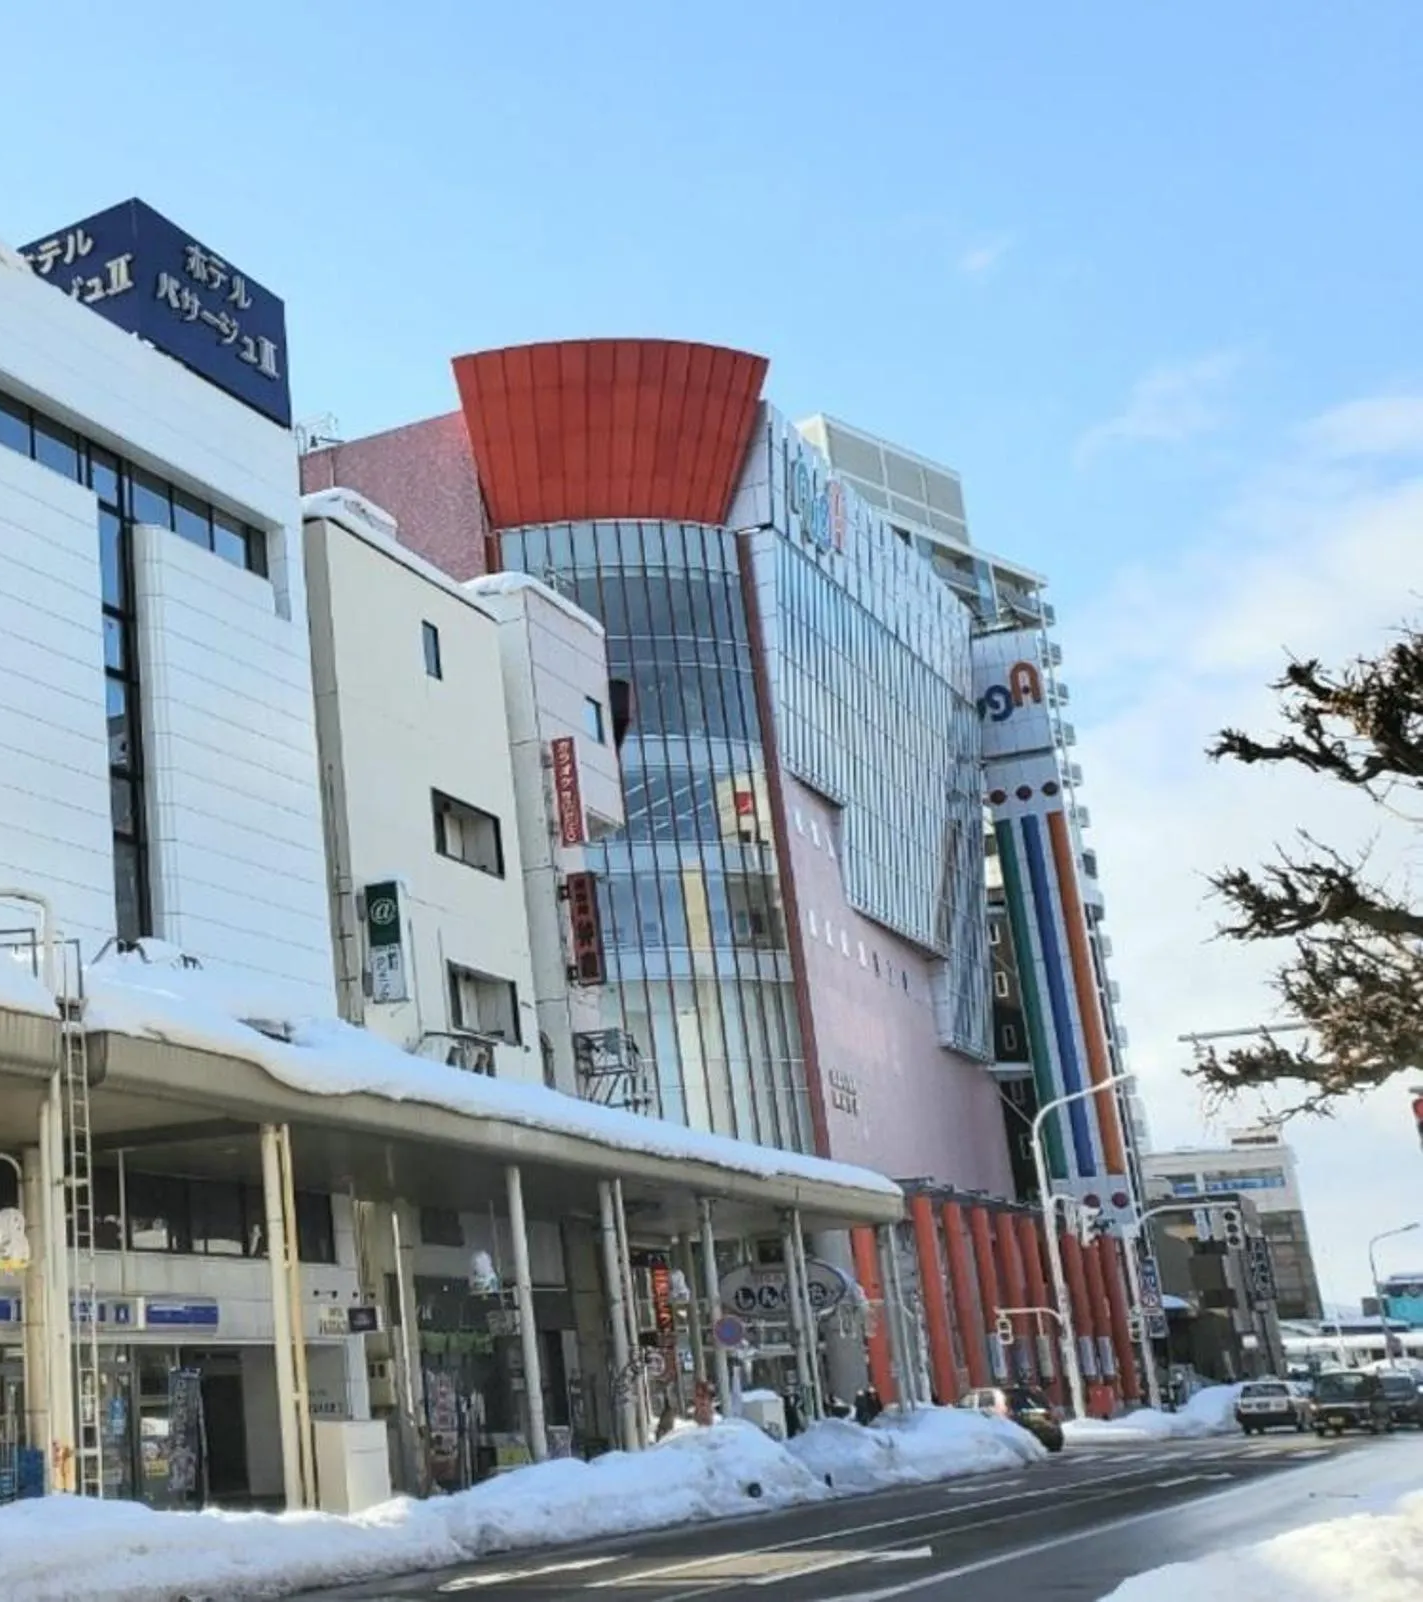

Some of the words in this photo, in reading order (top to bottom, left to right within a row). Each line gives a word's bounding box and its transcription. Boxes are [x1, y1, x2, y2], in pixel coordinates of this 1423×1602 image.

[25, 229, 94, 274] テル
[184, 245, 253, 309] ホテル
